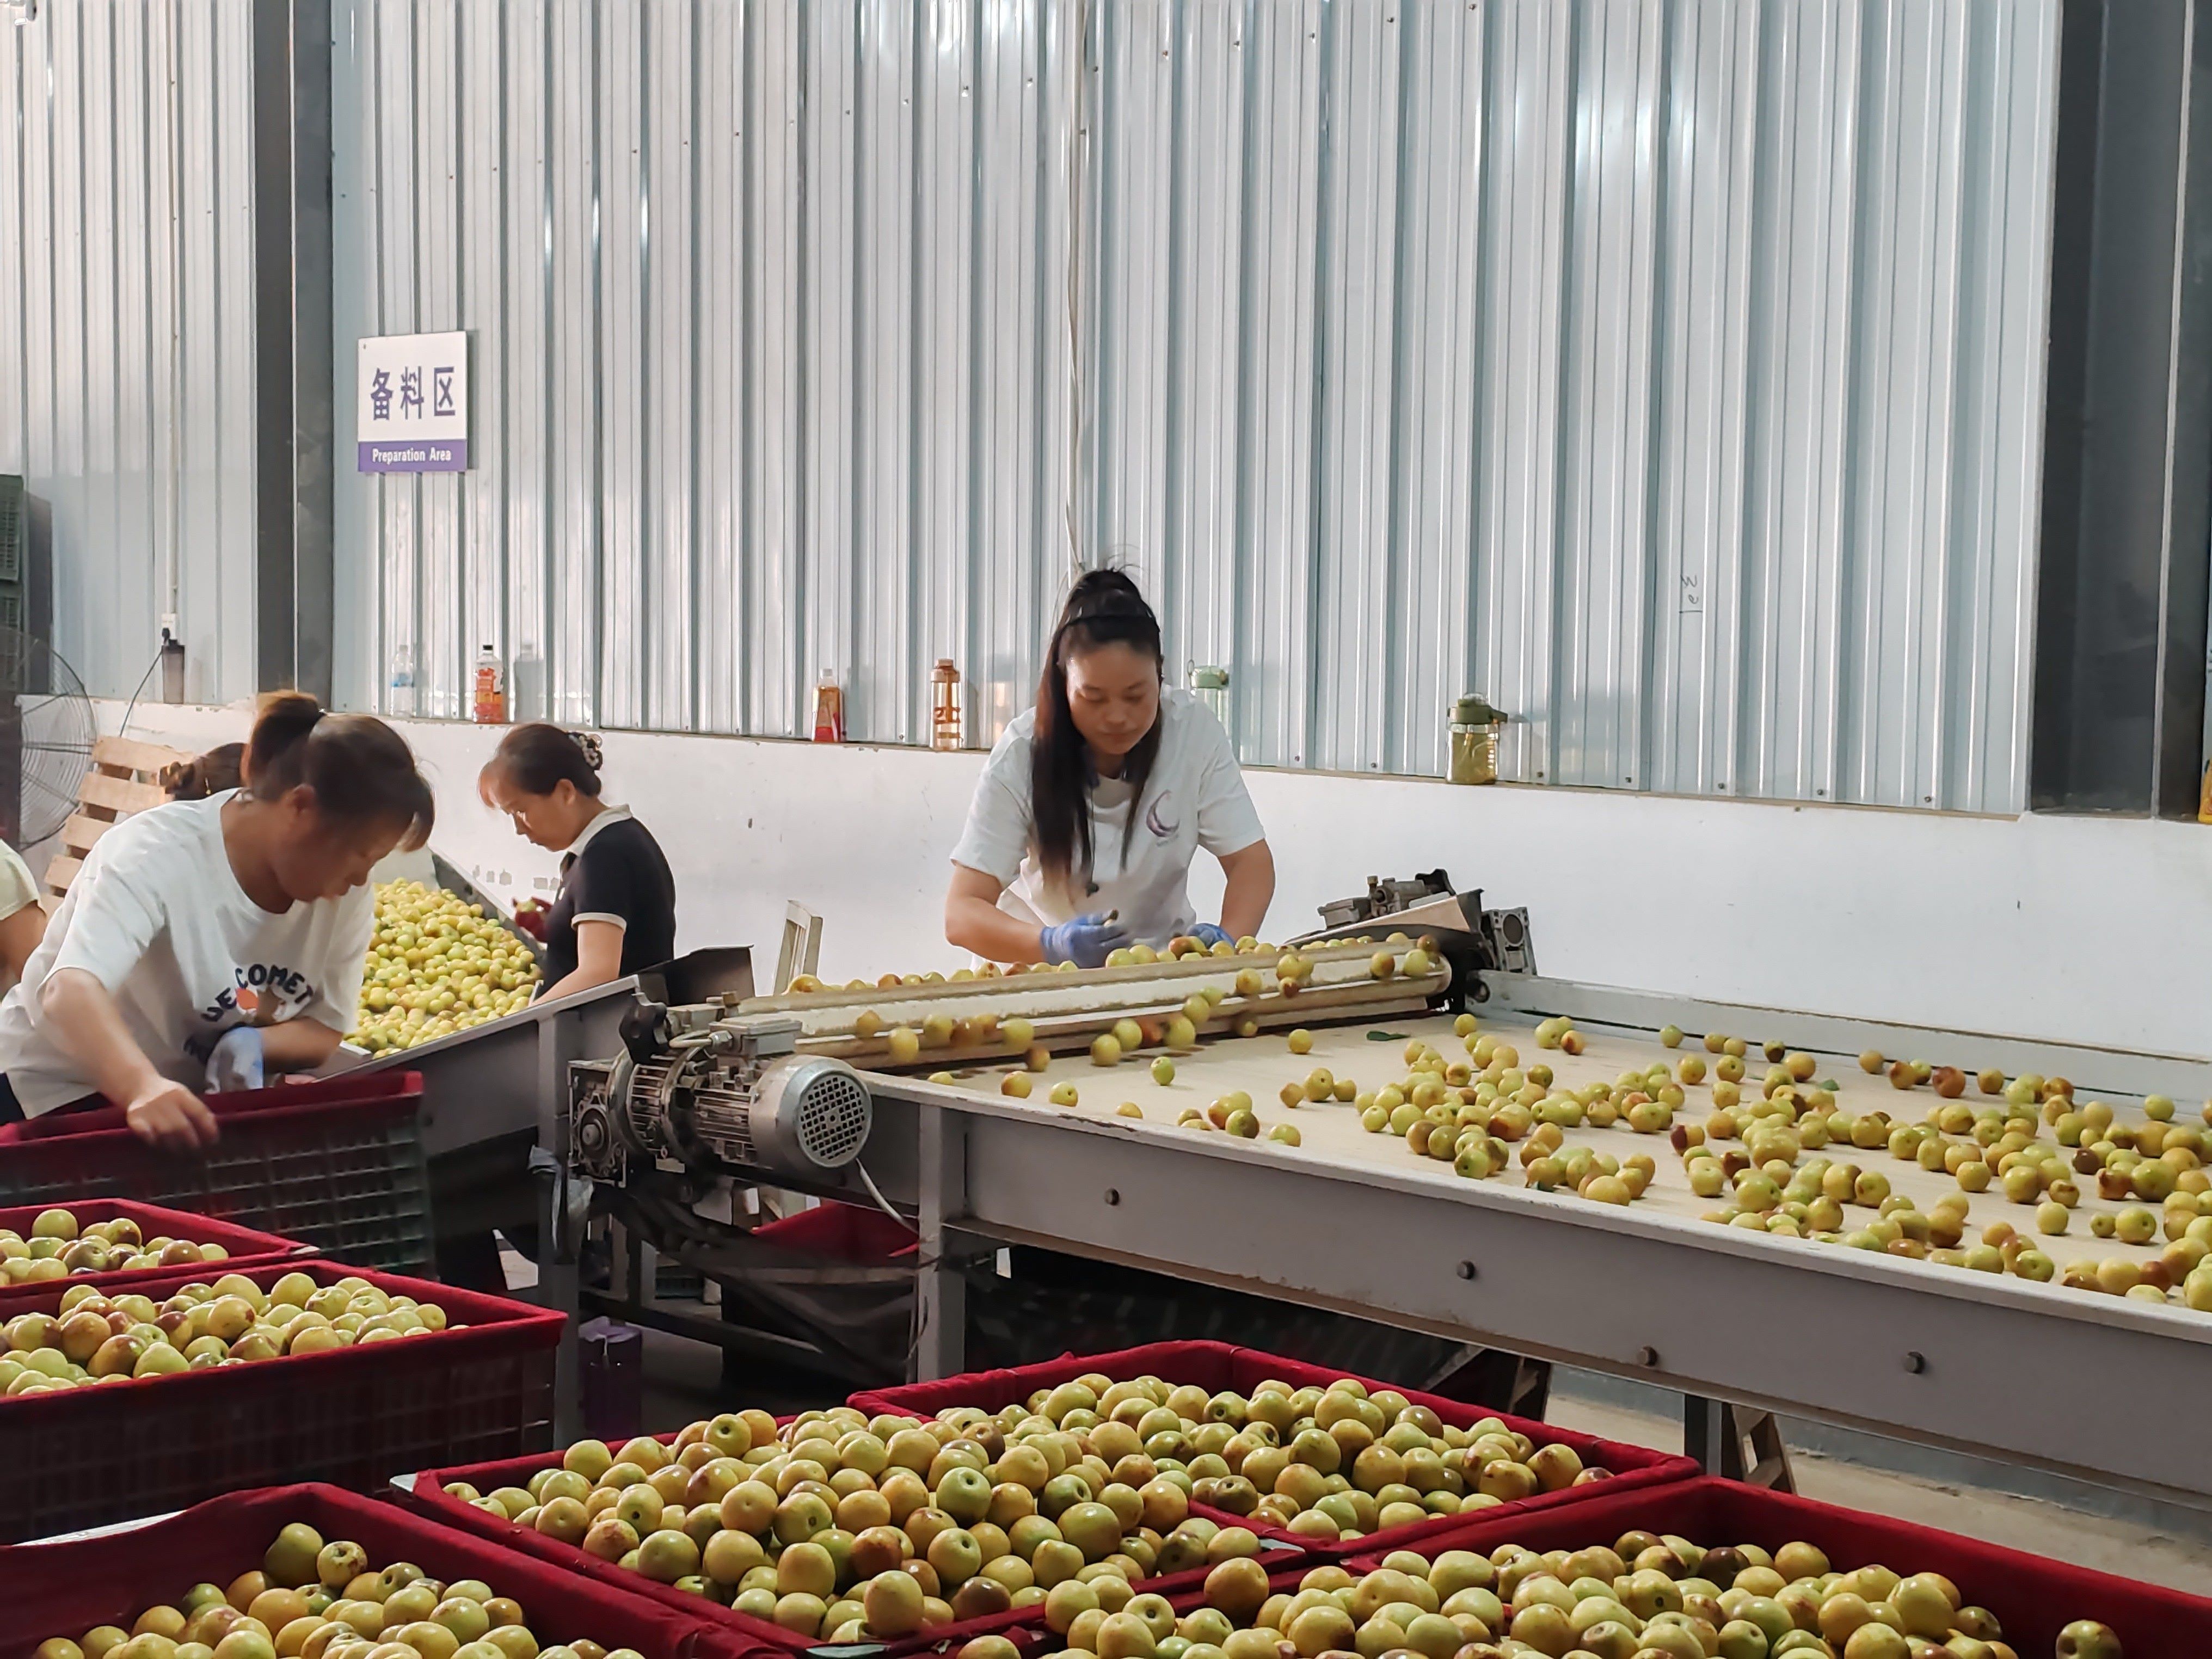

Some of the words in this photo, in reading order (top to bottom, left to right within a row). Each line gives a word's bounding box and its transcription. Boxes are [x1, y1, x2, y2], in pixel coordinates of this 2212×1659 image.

[370, 366, 456, 421] 备料区
[372, 447, 426, 465] Preparation
[429, 446, 452, 462] Area
